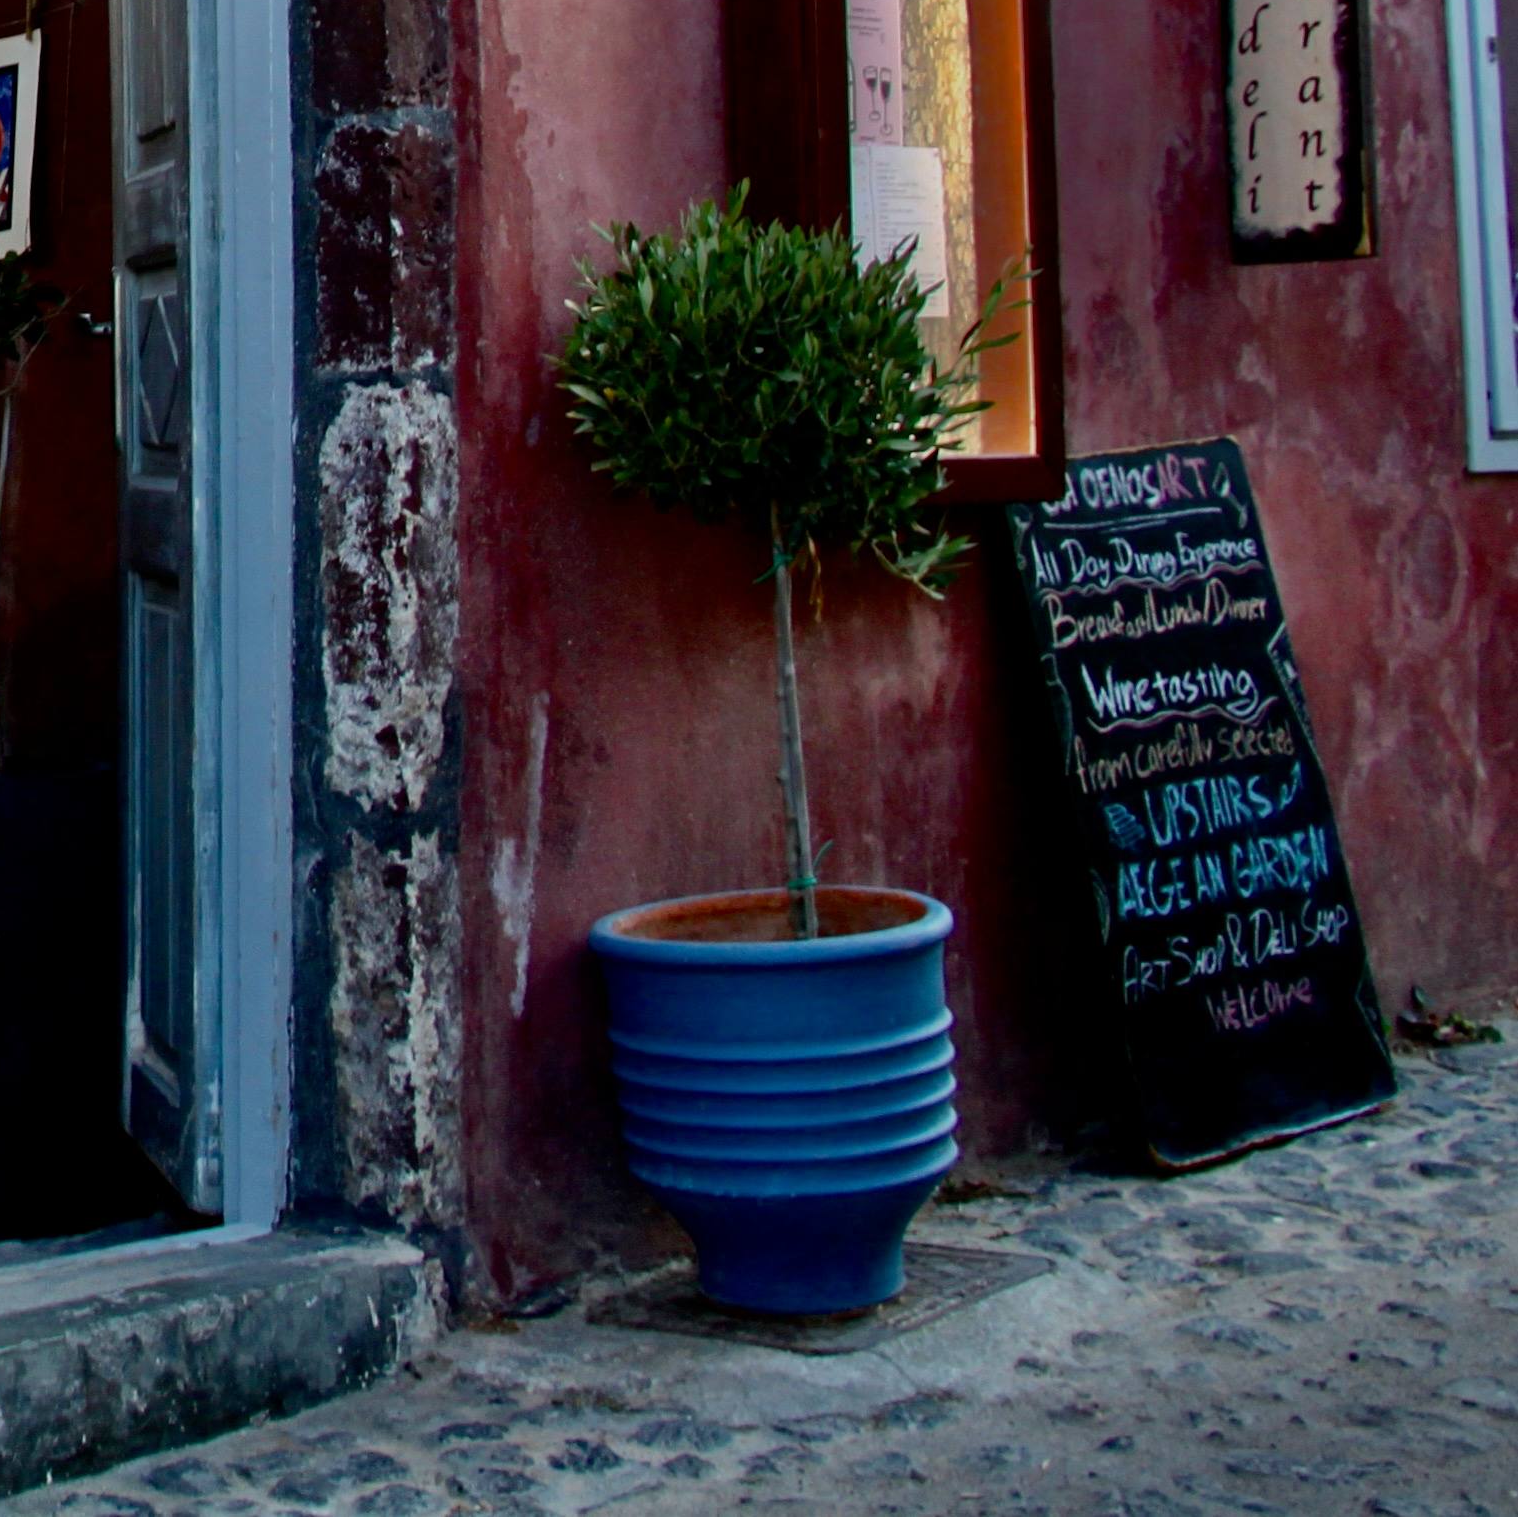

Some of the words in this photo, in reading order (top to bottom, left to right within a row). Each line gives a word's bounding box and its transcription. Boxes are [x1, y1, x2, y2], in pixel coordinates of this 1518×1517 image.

[1237, 3, 1270, 215] deli
[1079, 453, 1207, 509] OENOSART
[1031, 534, 1061, 587] All
[1061, 538, 1111, 587] Day
[1074, 735, 1133, 794] from
[1218, 719, 1295, 763] selected
[1143, 775, 1273, 847] UPSTAIRS
[1231, 824, 1329, 898] GARDEN
[1226, 913, 1249, 969] &
